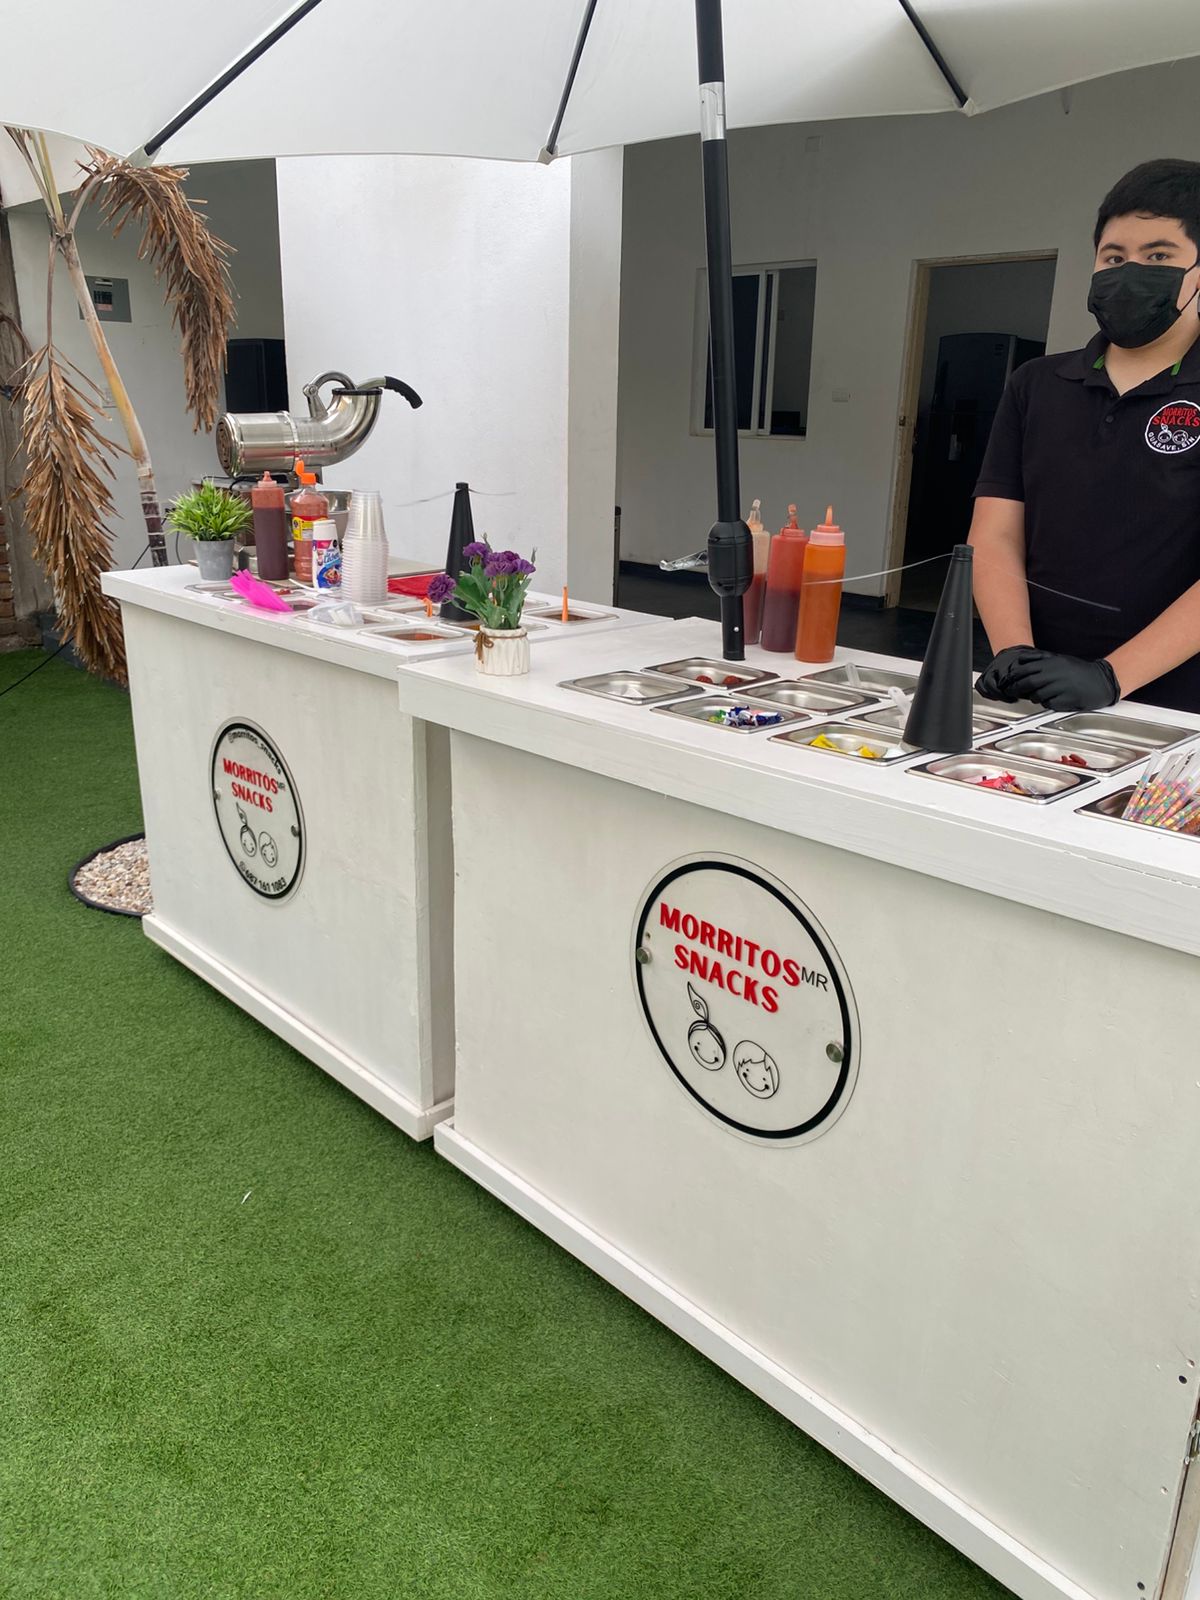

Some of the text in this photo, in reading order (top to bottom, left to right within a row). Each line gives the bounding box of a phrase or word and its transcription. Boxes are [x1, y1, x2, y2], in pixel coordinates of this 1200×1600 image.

[1152, 416, 1200, 427] SNACKS
[223, 757, 278, 795] MORRITOS
[231, 781, 273, 813] SNACKS
[660, 902, 828, 992] MORRITOS MR
[674, 943, 780, 1014] SNACKS
